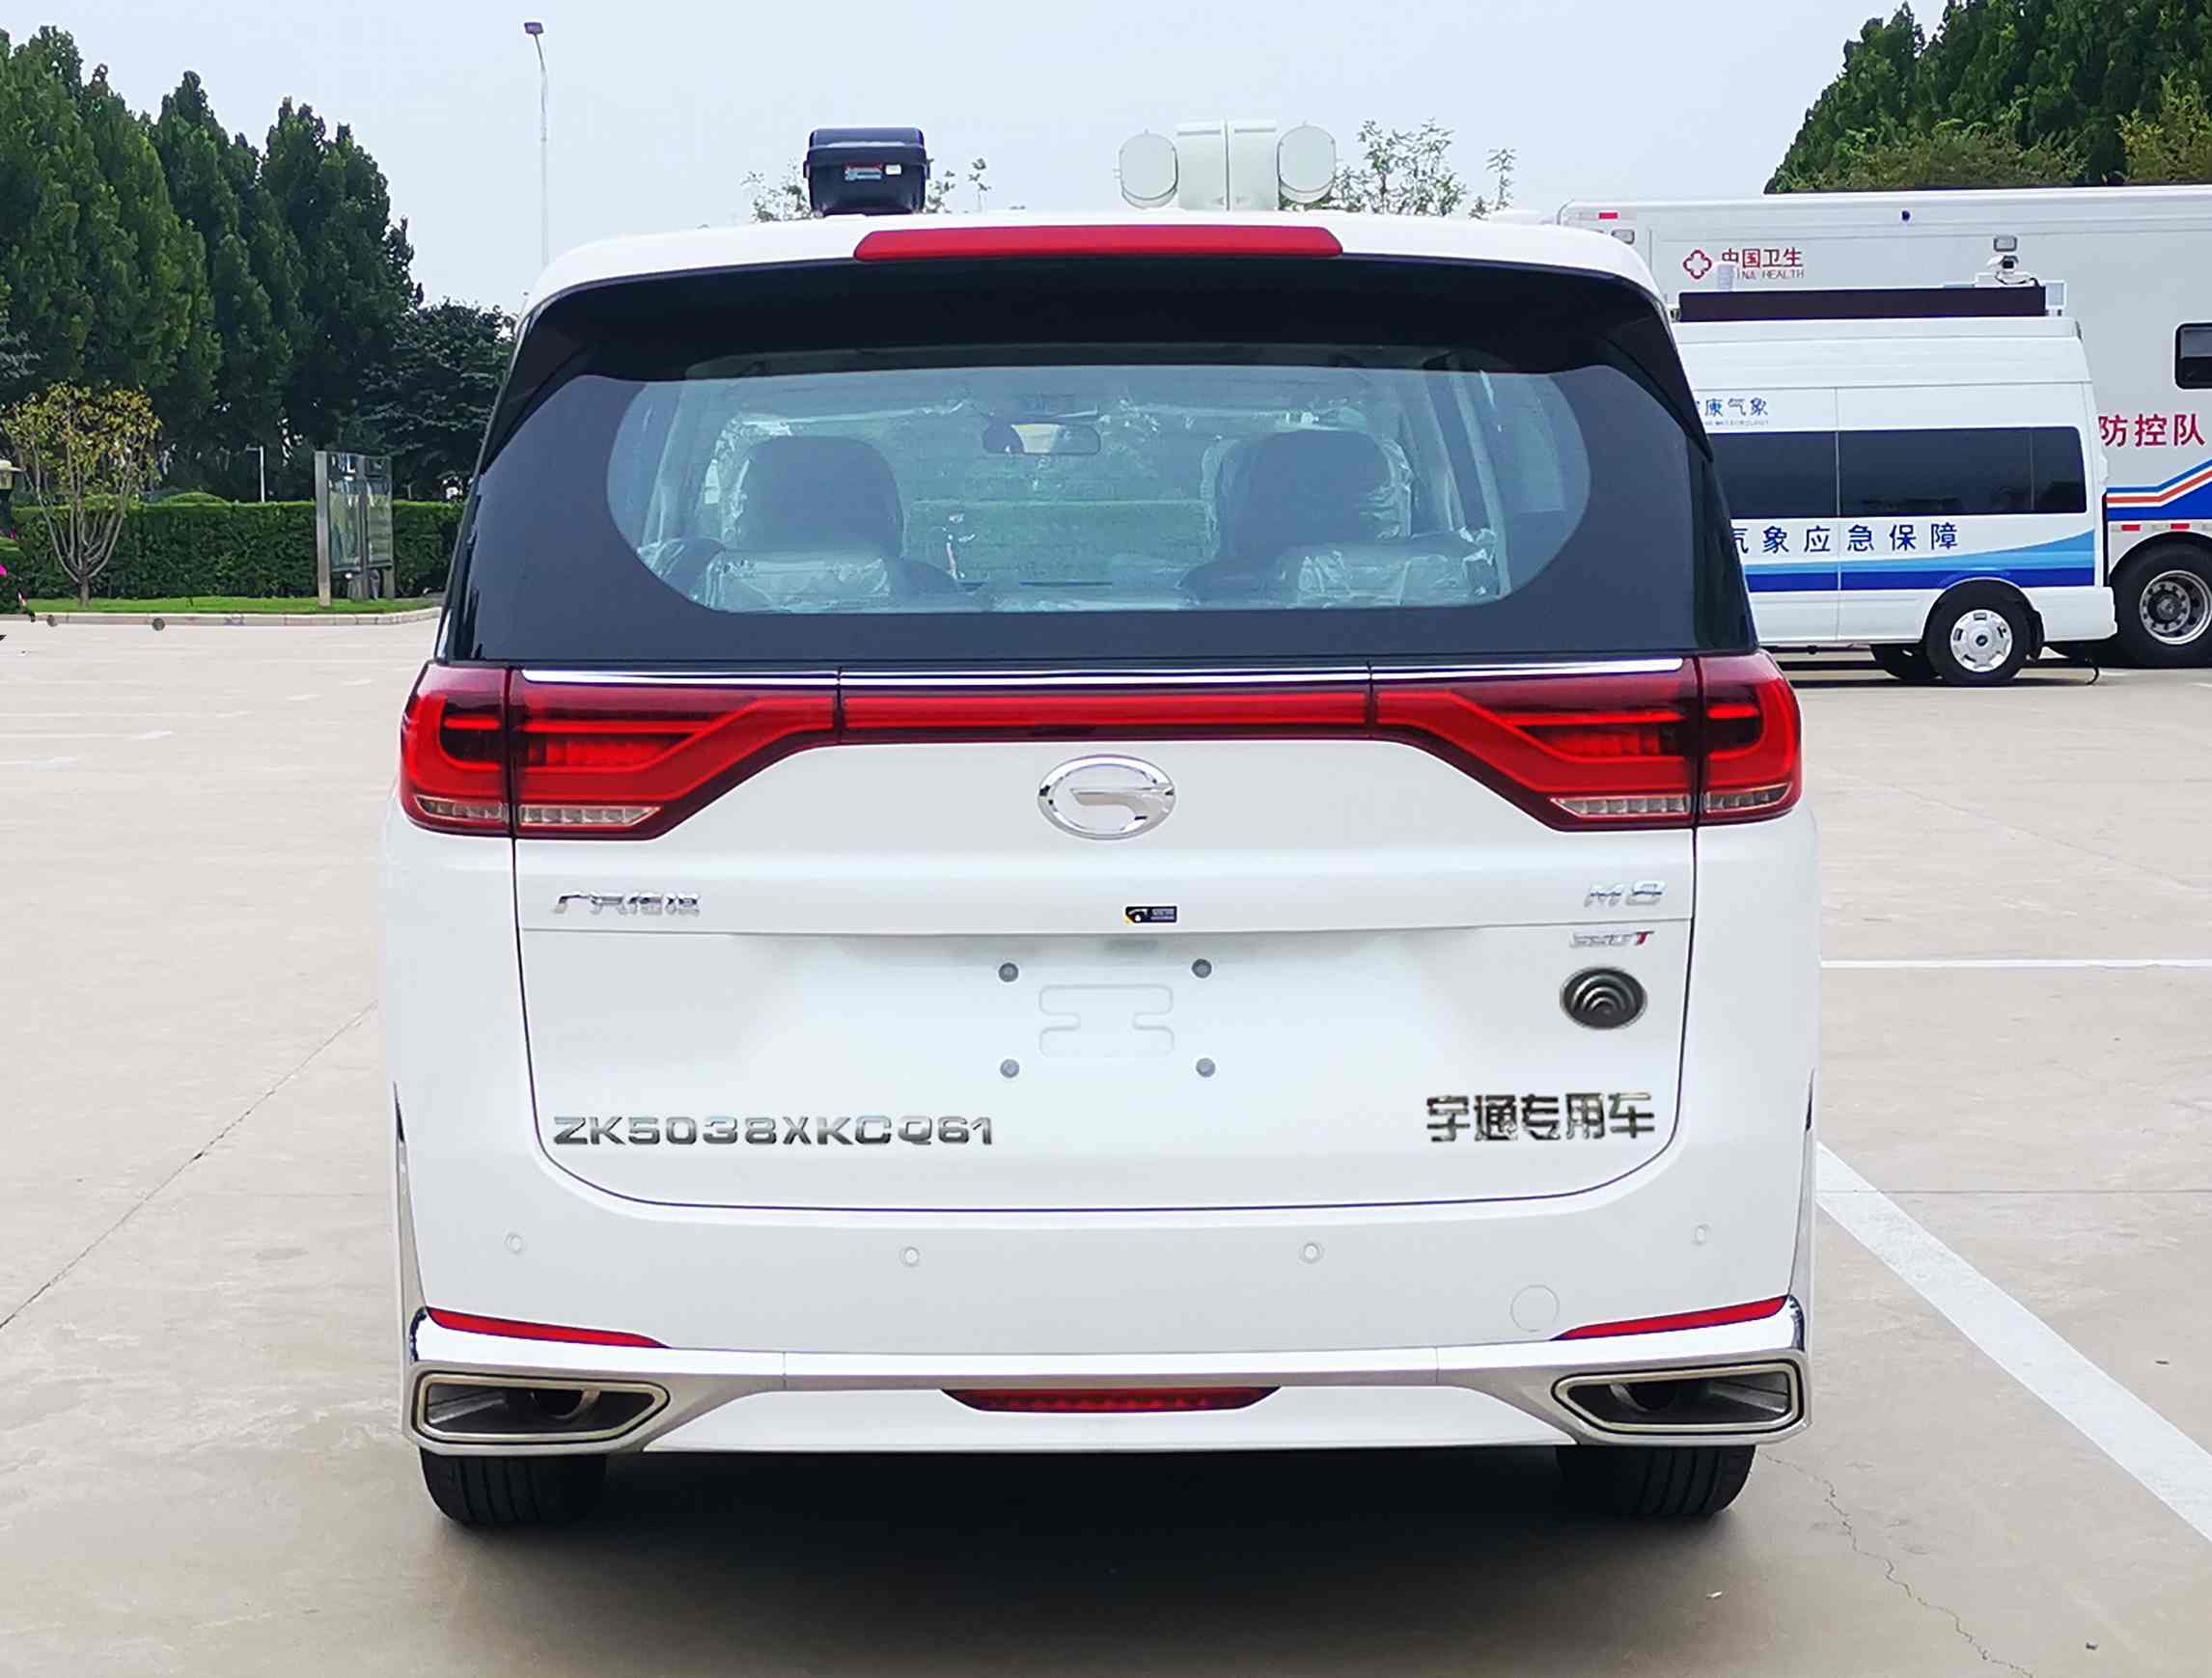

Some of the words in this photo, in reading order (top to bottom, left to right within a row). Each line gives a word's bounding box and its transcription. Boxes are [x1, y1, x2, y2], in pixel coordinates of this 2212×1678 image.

[1721, 247, 1803, 268] 中国卫生
[1697, 398, 1768, 417] 康气象
[2098, 413, 2205, 447] 防控队
[1732, 522, 1958, 554] 气象应急保障
[553, 1115, 993, 1145] ZK5038XKCQ61
[1426, 1092, 1655, 1142] 宇通专用车
